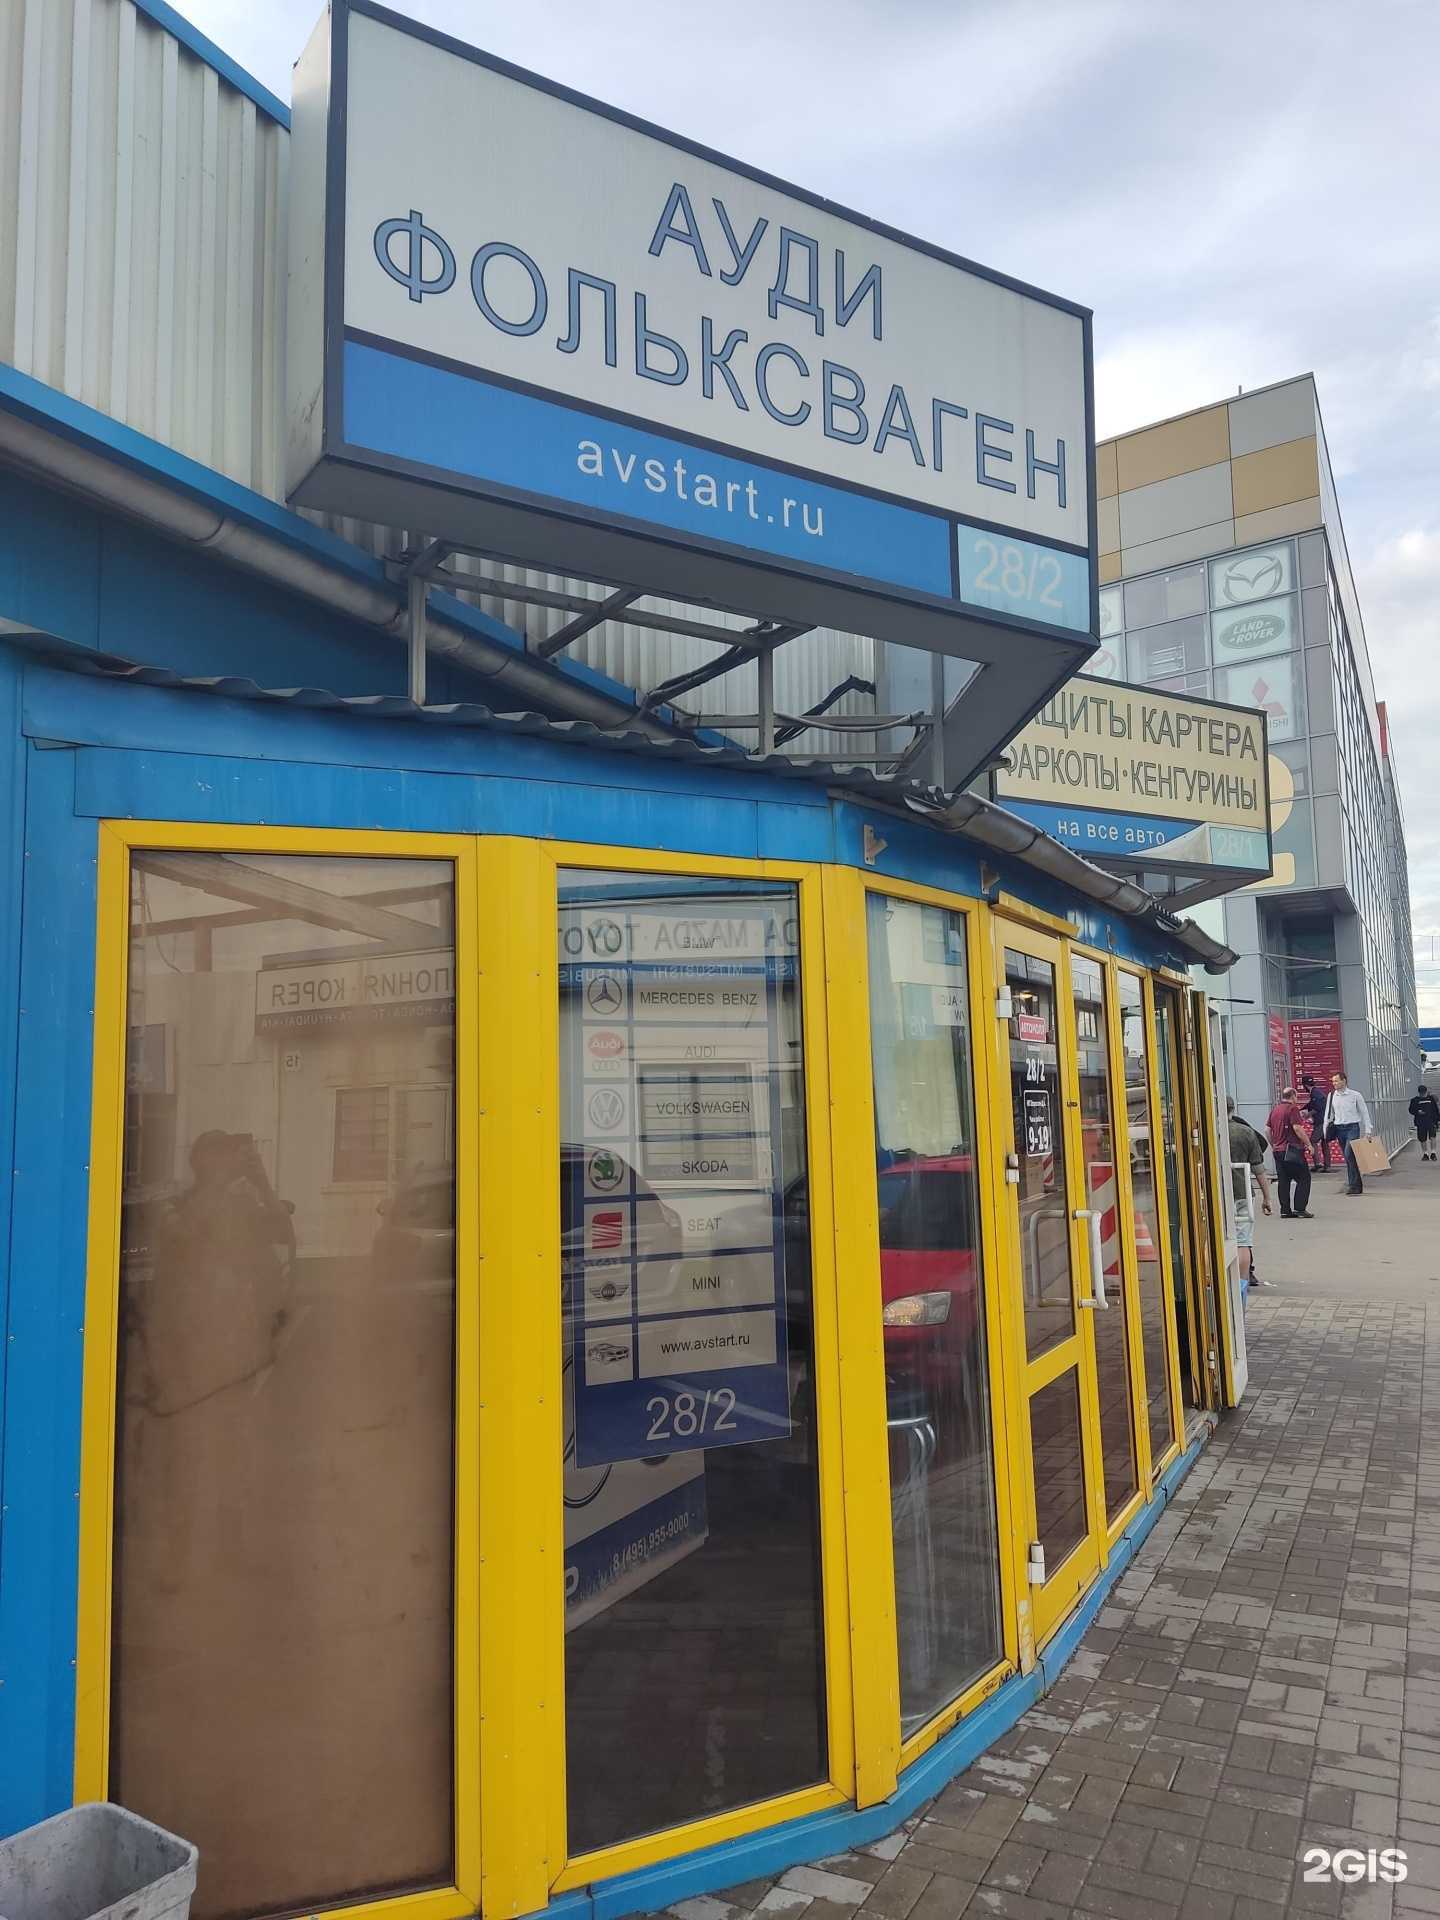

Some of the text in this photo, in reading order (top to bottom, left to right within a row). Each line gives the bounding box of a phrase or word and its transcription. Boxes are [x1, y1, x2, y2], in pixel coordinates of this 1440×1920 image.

[648, 183, 883, 340] АУДИ
[373, 209, 1067, 508] ФОЛЬКСВАГЕН
[576, 438, 825, 538] avstart.ru
[973, 538, 1063, 609] 28/2
[1034, 691, 1258, 761] ЩИТЫ КАРТЕРА
[1058, 819, 1165, 844] на все авто
[640, 991, 758, 1006] MERCEDES BENZ
[684, 1046, 716, 1058] AUDI
[1025, 1057, 1046, 1083] 28/2
[656, 1101, 750, 1115] VOLKSWAGEN
[1028, 1126, 1049, 1152] 9-19
[682, 1160, 729, 1174] SKODA
[687, 1216, 721, 1233] SEAT
[692, 1276, 721, 1290] MINI
[660, 1333, 751, 1355] www.avstart.ru
[645, 1387, 738, 1441] 28/2
